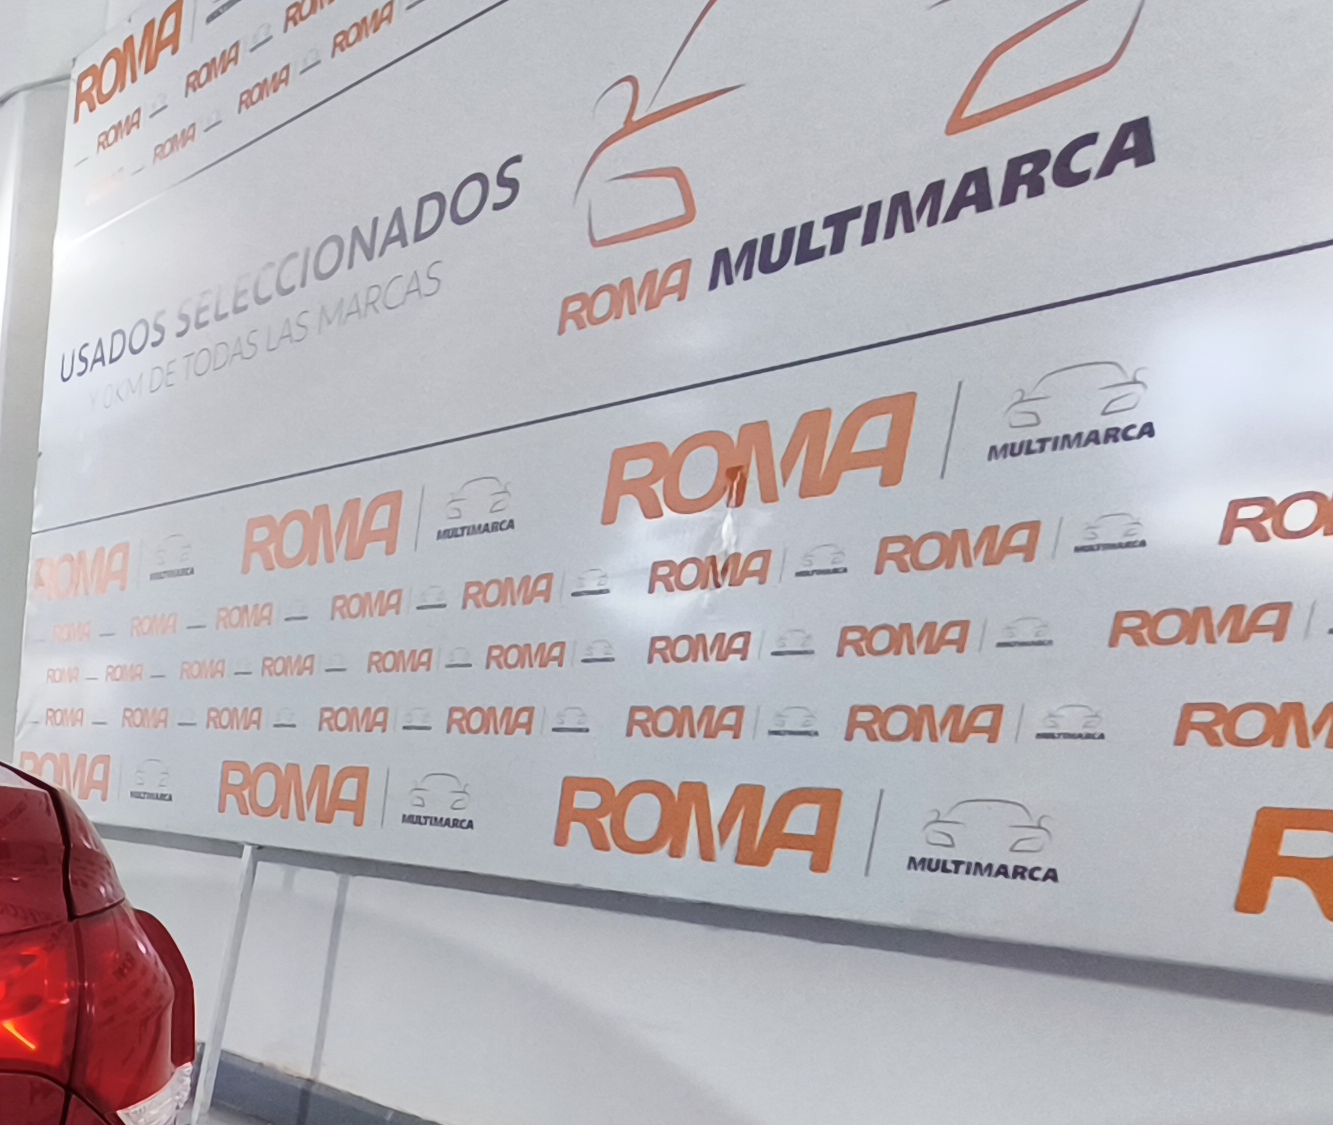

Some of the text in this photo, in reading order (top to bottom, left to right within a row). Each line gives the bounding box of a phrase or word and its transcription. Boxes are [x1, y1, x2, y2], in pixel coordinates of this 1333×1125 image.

[330, 0, 395, 58] ROMA
[74, 0, 183, 125] ROMA
[184, 40, 241, 98] ROMA
[237, 63, 291, 114] ROMA
[96, 106, 142, 154] ROMA
[153, 122, 197, 164] ROMA
[557, 116, 1156, 336] ROMA MULTIMARCA
[60, 154, 523, 383] USADOS SELECCIONADOS
[149, 359, 177, 394] DE
[182, 328, 259, 382] TODAS
[266, 310, 309, 352] LAS
[318, 260, 443, 336] MARCAS
[601, 392, 1156, 526] ROMA MULTIMARCA
[241, 490, 515, 575] ROMA MULTIMARCA
[1218, 491, 1333, 546] RO
[874, 520, 1042, 576] ROMA
[33, 542, 131, 600] ROMA
[461, 572, 554, 610] ROMA
[648, 549, 773, 594] ROMA
[130, 613, 178, 637] ROMA
[216, 603, 274, 631] ROMA
[331, 589, 403, 620] ROMA
[1107, 601, 1293, 649] ROMA
[485, 641, 567, 670] ROMA
[647, 631, 751, 665] ROMA
[836, 619, 972, 659] ROMA
[106, 664, 143, 682] ROMA
[180, 659, 226, 680] ROMA
[262, 654, 315, 678] ROMA
[367, 648, 433, 674] ROMA
[45, 707, 84, 728] ROMA
[121, 707, 169, 729] ROMA
[206, 706, 263, 731] ROMA
[318, 706, 389, 733] ROMA
[446, 706, 535, 736] ROMA
[626, 705, 745, 740] ROMA
[844, 703, 1005, 745] ROMA
[1174, 702, 1333, 750] ROM
[218, 761, 474, 831] ROMA MULTIMARCA
[554, 776, 1059, 884] ROMA MULTIMARCA
